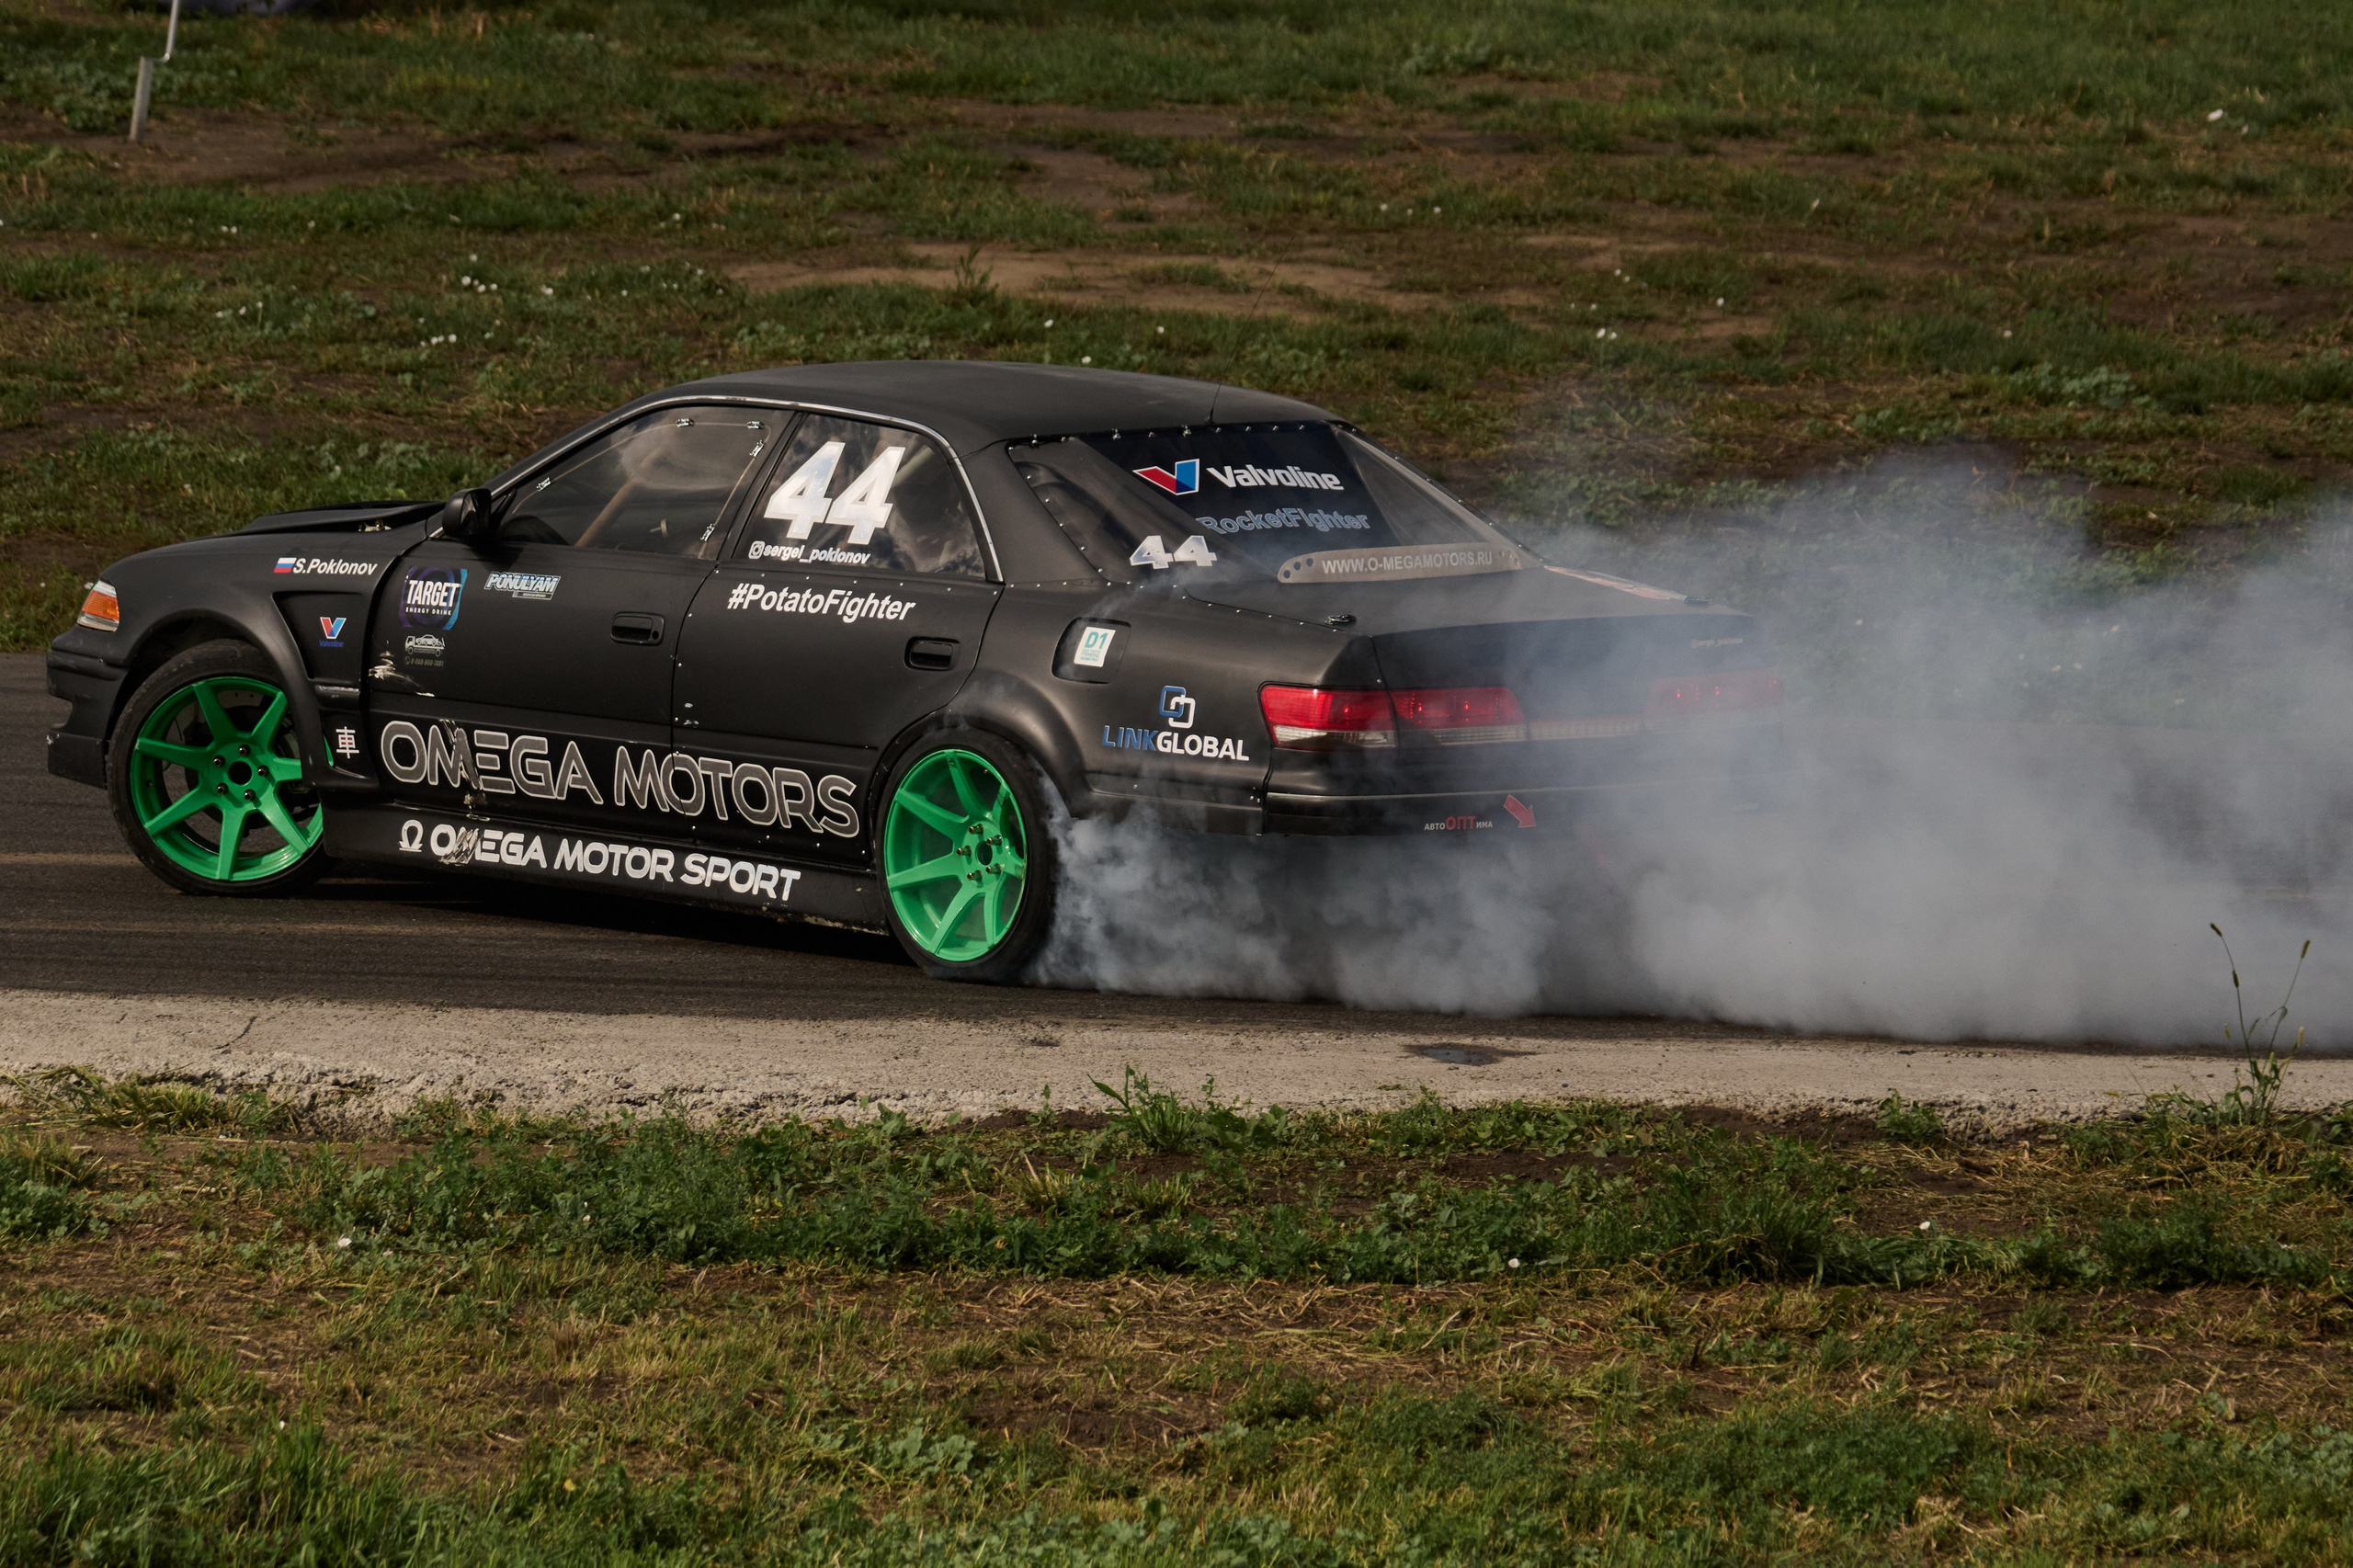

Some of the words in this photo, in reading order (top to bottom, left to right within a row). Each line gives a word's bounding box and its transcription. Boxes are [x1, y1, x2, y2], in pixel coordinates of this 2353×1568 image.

[764, 441, 905, 545] 44
[1207, 464, 1344, 490] Valvoline
[293, 558, 378, 575] S.Poklonov
[1130, 535, 1217, 569] 44
[1322, 551, 1493, 574] WWW.O-MEGAMOTORS.RU
[406, 579, 461, 607] TARGET
[727, 583, 916, 623] #PotatoFighter
[1085, 631, 1108, 649] D1
[335, 726, 360, 759] 車
[1102, 725, 1250, 761] LINKGLOBAL
[381, 721, 604, 805] OMEGA
[614, 745, 859, 837] MOTORS
[553, 838, 673, 882] MOTOR
[680, 853, 801, 902] SPORT
